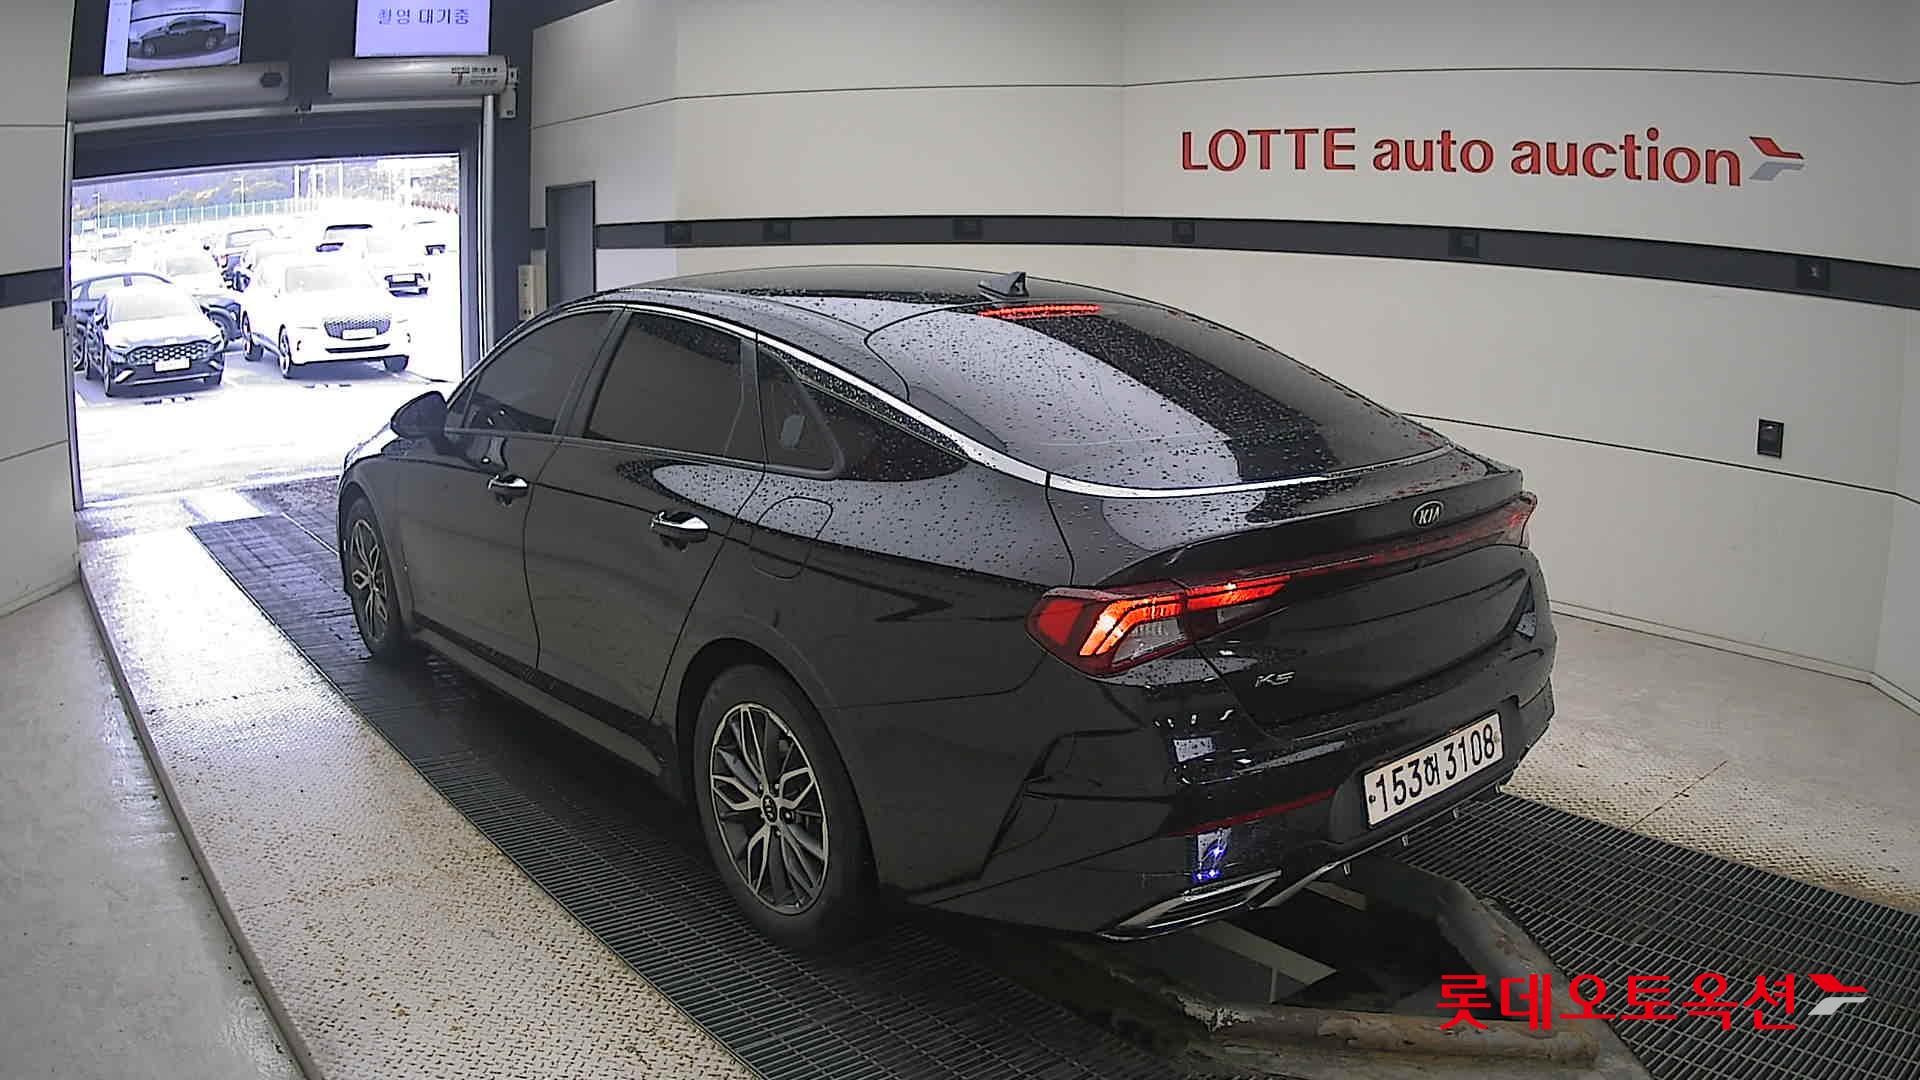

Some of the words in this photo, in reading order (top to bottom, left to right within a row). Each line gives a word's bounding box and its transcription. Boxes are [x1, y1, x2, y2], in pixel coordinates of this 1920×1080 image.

[1181, 127, 1357, 171] LOTTE
[1373, 130, 1495, 173] auto
[1511, 127, 1742, 187] auction
[1418, 505, 1441, 525] KIA
[1255, 671, 1296, 688] K5
